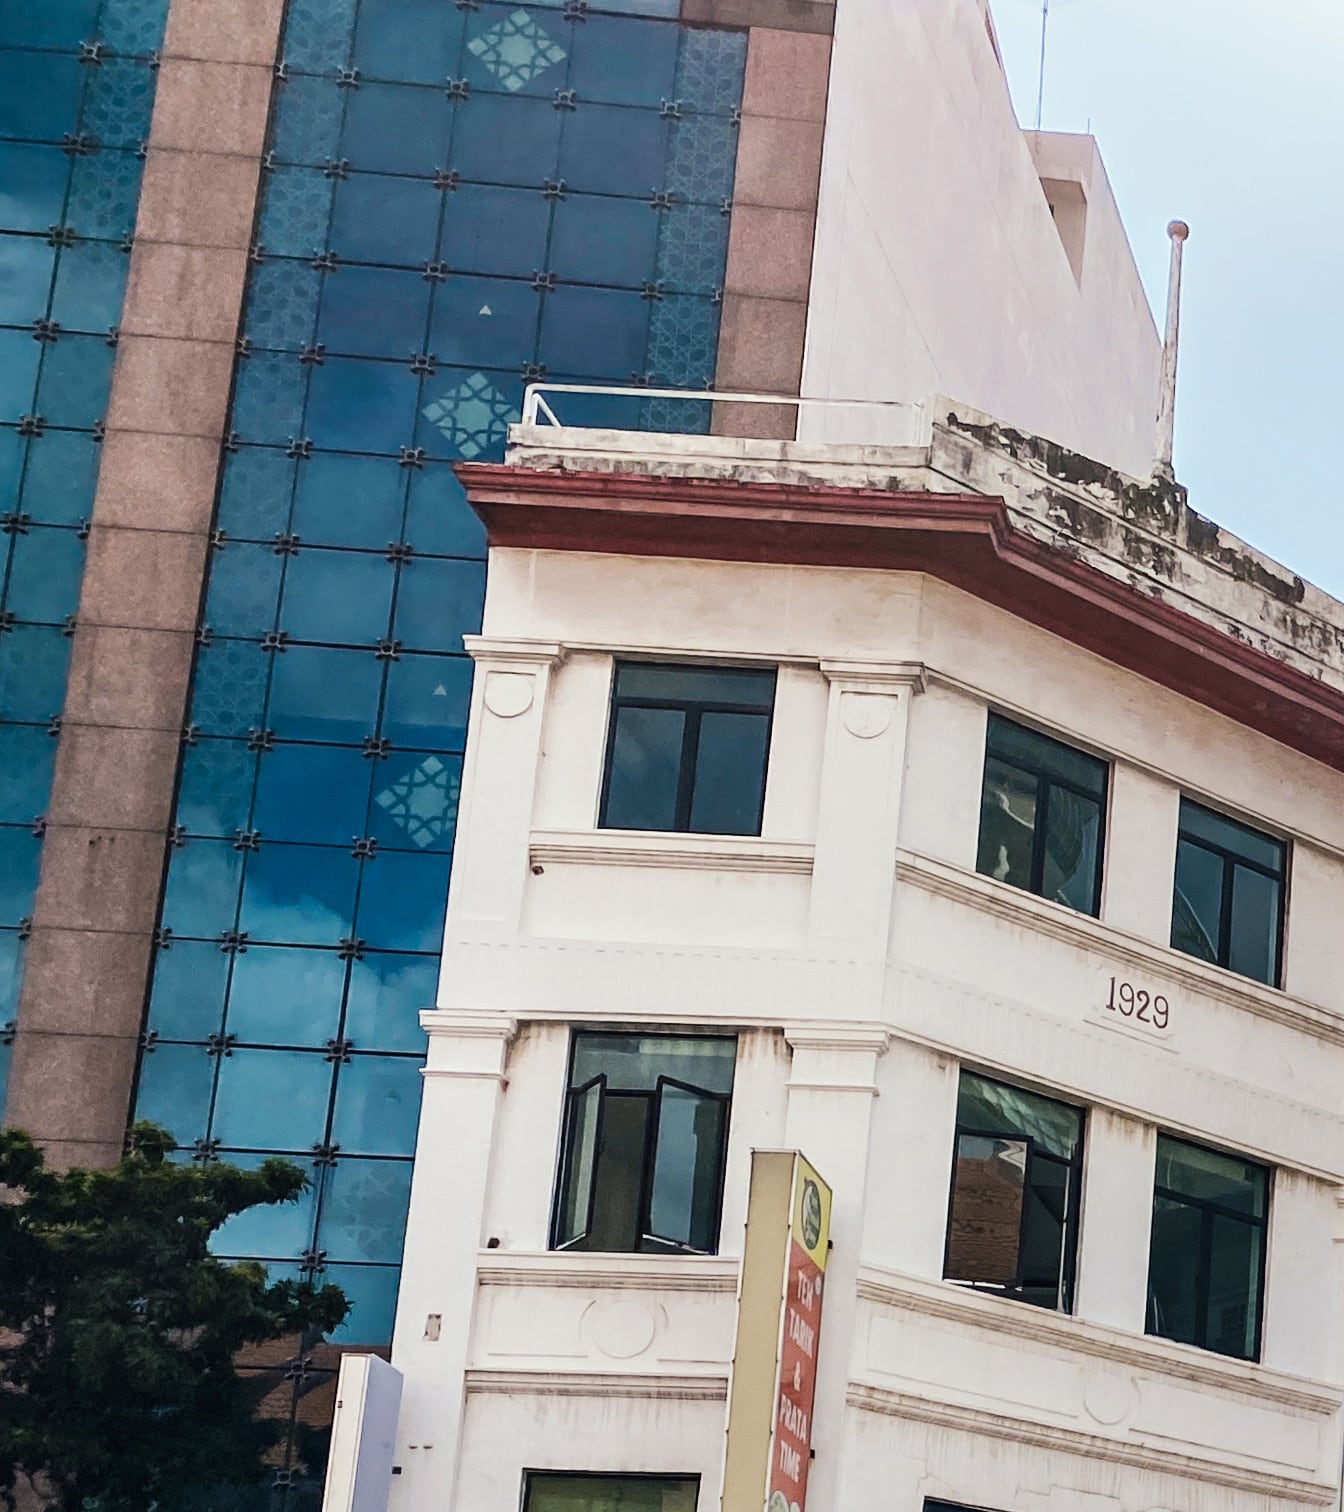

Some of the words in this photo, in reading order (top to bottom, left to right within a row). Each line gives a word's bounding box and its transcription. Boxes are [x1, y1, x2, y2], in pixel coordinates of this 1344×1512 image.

[1105, 976, 1169, 1029] 1929
[798, 1270, 814, 1312] TEH
[789, 1307, 815, 1360] TARIK
[780, 1393, 808, 1444] PRATA
[779, 1440, 801, 1484] TIME
